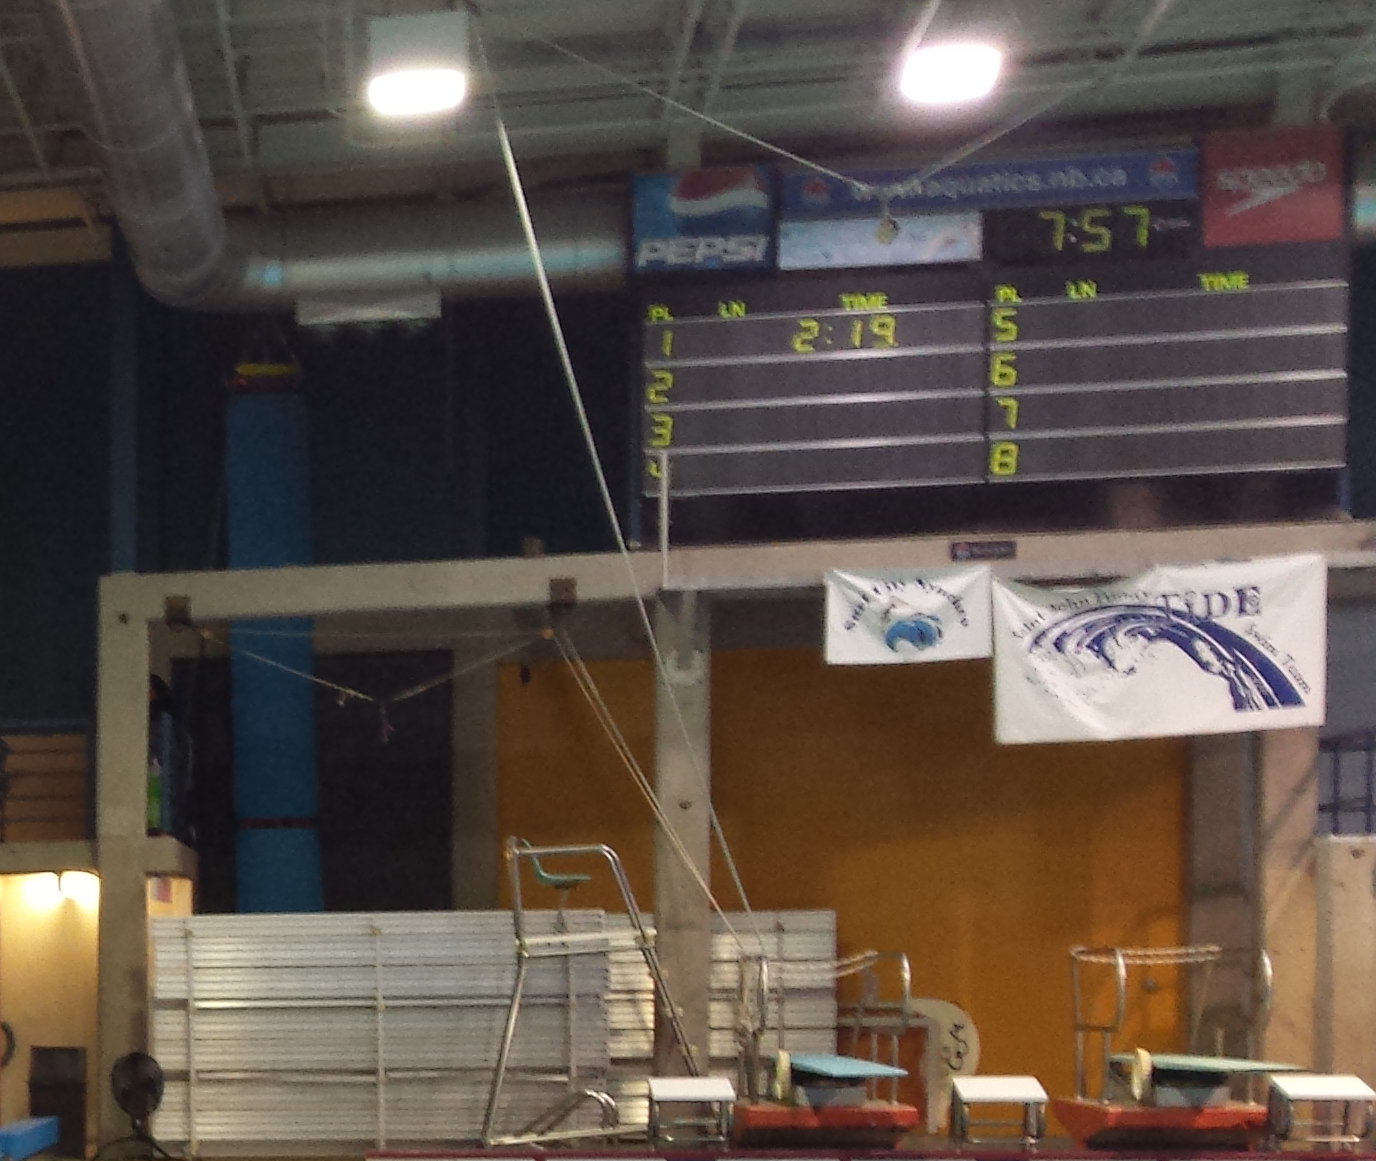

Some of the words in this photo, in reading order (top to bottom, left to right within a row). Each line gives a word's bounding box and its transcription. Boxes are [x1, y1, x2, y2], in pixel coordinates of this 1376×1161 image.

[1039, 205, 1151, 252] 7:57
[637, 234, 769, 268] PEPSI
[993, 283, 1021, 303] PL
[1065, 280, 1097, 299] LN
[1198, 270, 1249, 291] TIME
[648, 303, 674, 322] PL
[717, 300, 746, 318] LN
[839, 292, 888, 310] TIME
[991, 307, 1018, 342] 5
[661, 330, 673, 357] 1
[791, 314, 898, 354] 2:19
[647, 369, 674, 404] 2
[990, 351, 1018, 388] 6
[649, 412, 674, 448] 3
[996, 396, 1019, 430] 7
[989, 440, 1020, 477] 8
